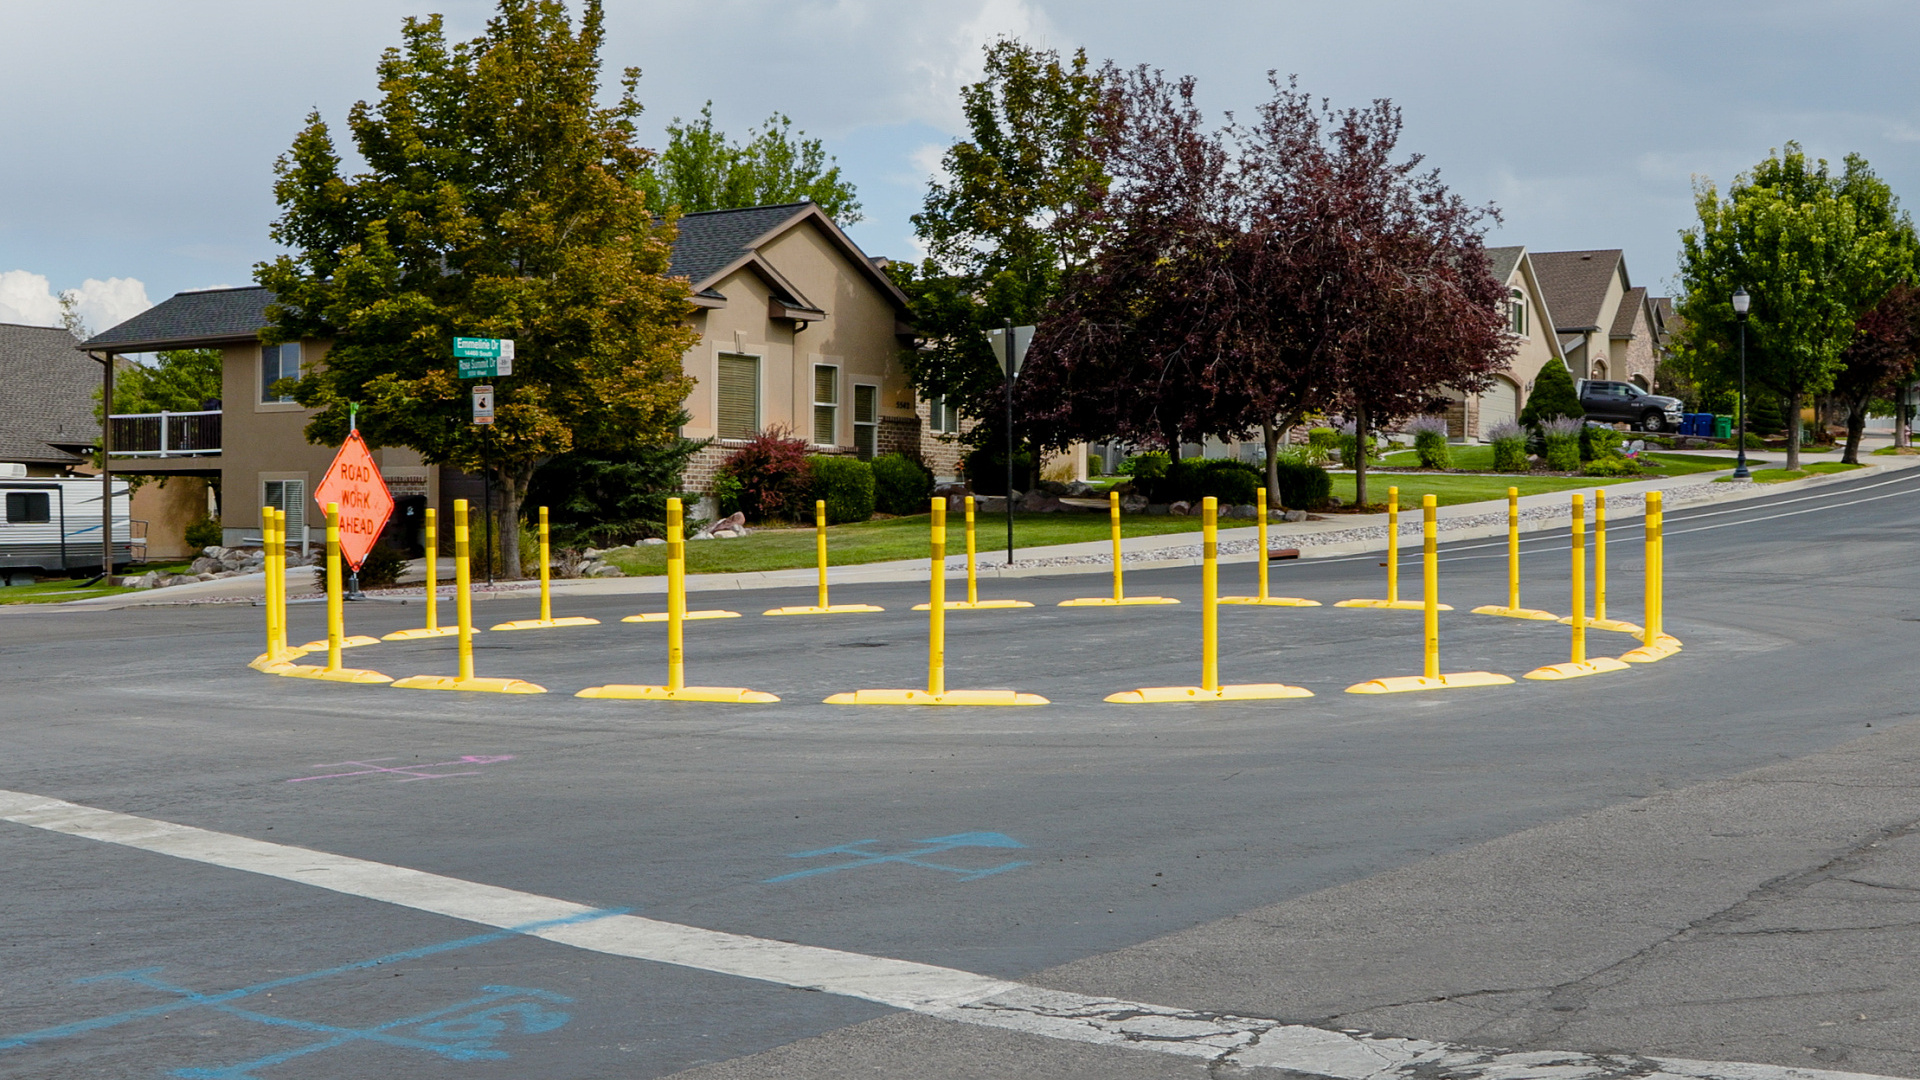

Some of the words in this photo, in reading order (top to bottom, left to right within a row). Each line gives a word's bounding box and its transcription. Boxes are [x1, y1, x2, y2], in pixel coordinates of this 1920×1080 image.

[457, 338, 490, 349] Emmeline
[491, 339, 499, 350] Dr
[471, 359, 488, 369] Summit
[489, 357, 495, 367] Dr
[341, 463, 370, 483] ROAD
[341, 490, 371, 509] WORK
[339, 516, 374, 535] AHEAD
